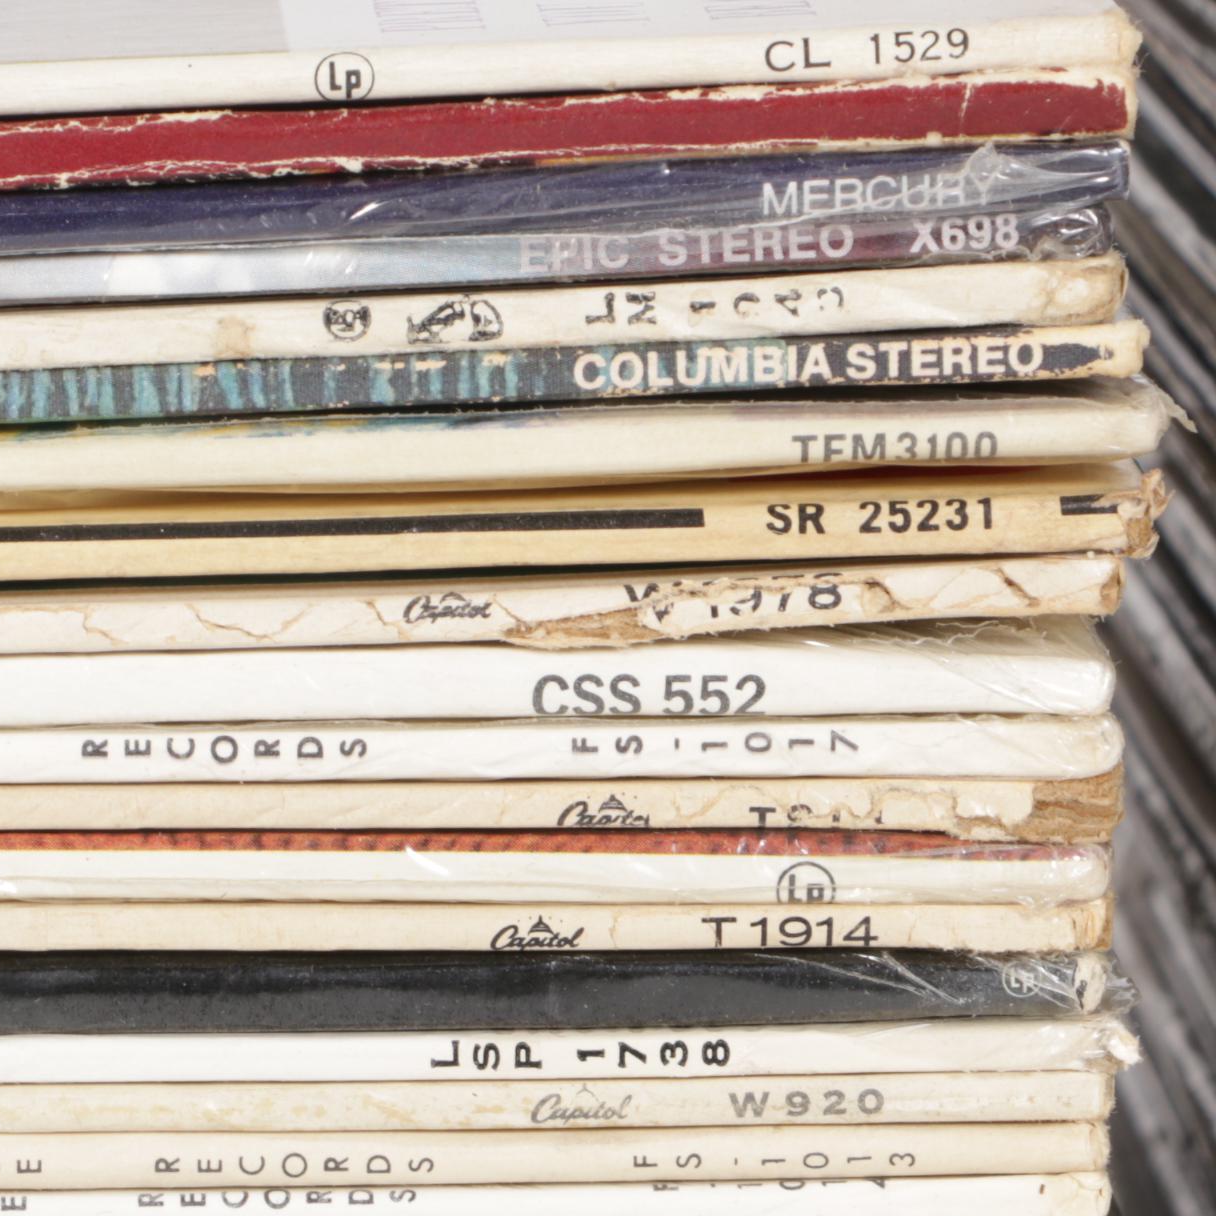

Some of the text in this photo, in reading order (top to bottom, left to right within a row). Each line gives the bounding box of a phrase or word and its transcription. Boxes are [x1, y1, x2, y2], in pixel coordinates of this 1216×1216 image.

[764, 28, 971, 72] CL 1529
[761, 168, 1000, 216] MERCURY
[519, 215, 1020, 274] EPIC STEREO X698
[573, 341, 1044, 391] COLUMBIA STEREO
[766, 497, 994, 536] SR 25231
[531, 673, 768, 716] CSS 552
[81, 732, 368, 761] RECORDS
[490, 924, 585, 951] Capitol
[701, 914, 881, 949] T 1914
[431, 1038, 730, 1072] LSP 1738
[530, 1093, 631, 1127] Capitol
[728, 1087, 885, 1119] W 920
[155, 1152, 435, 1178] RECORDS
